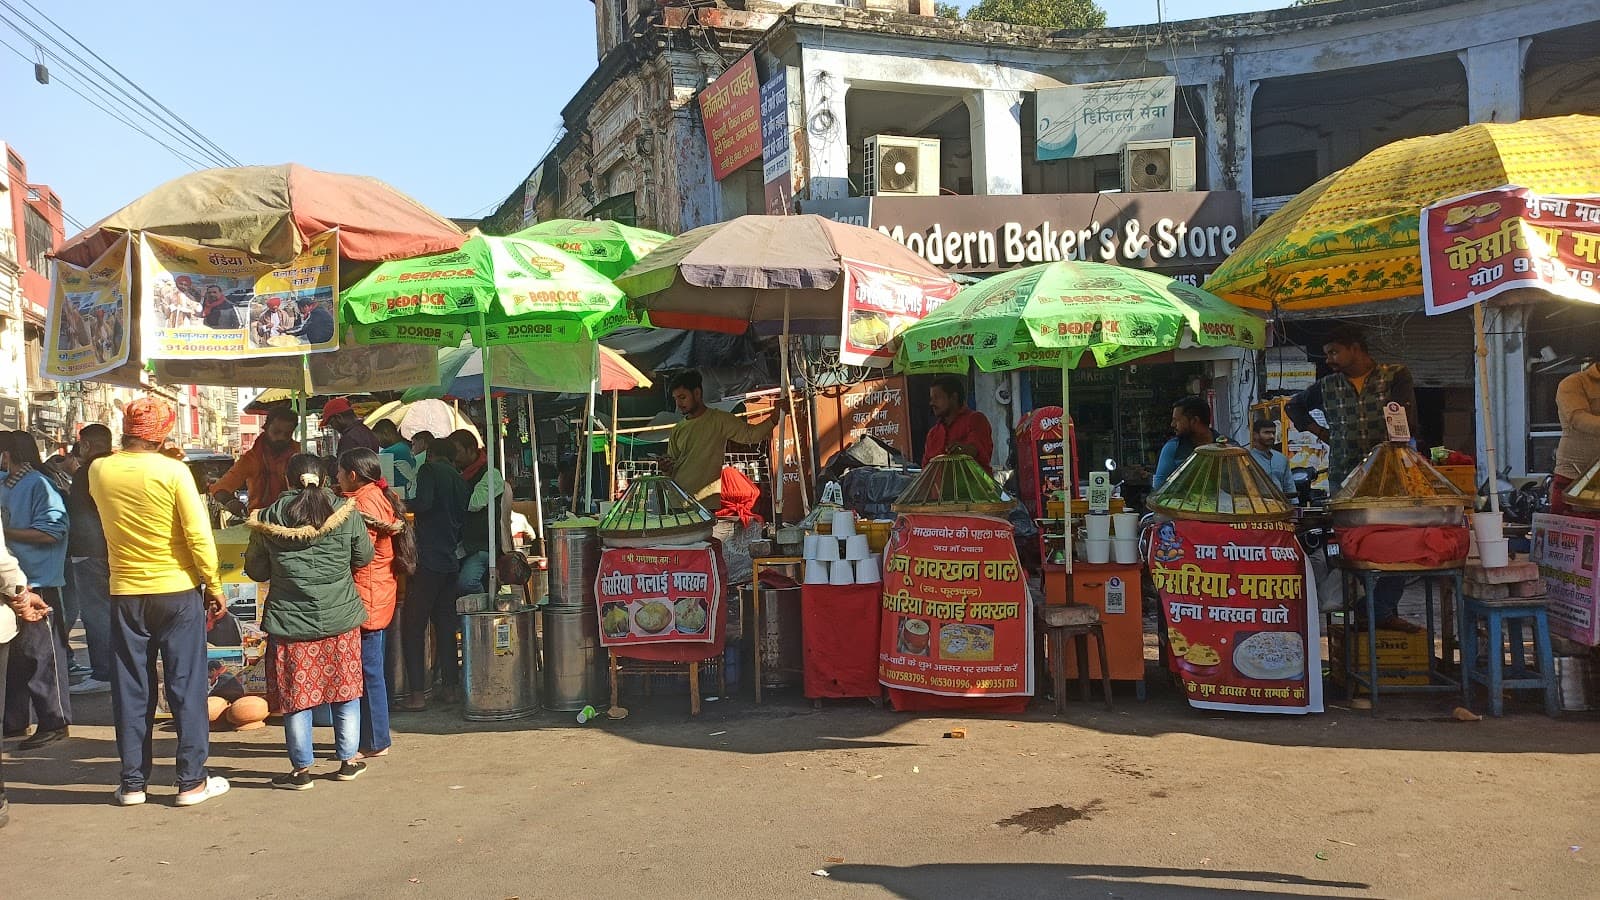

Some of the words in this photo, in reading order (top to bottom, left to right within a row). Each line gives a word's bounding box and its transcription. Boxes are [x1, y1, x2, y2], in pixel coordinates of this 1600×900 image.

[1082, 106, 1135, 125] डिजिटल
[1140, 102, 1168, 119] सेवा
[876, 223, 996, 265] Modern
[1004, 220, 1116, 264] Baker's
[1124, 218, 1150, 260] &
[1156, 217, 1237, 260] Store
[386, 292, 447, 311] BEDROCK
[528, 290, 580, 304] BEDROCK
[1058, 320, 1120, 336] BEDROCK
[844, 391, 865, 410] वाहन
[853, 411, 871, 424] वाहन
[956, 526, 968, 539] की
[1194, 545, 1218, 560] राम
[1222, 542, 1267, 561] गोपाल
[914, 557, 980, 581] मक्खन
[983, 553, 1019, 582] वाले
[600, 570, 633, 596] केसरिया
[635, 570, 669, 595] मलाई
[672, 572, 708, 593] मक्खन
[1151, 561, 1231, 598] केसरिया
[1238, 574, 1302, 600] मक्खन
[925, 596, 966, 622] मलाई
[969, 601, 1020, 621] मक्खन
[1169, 602, 1204, 623] मुन्ना
[1207, 605, 1257, 624] मक्खन
[1260, 604, 1289, 625] वाले
[934, 664, 961, 673] अवसर
[962, 666, 974, 674] पर
[975, 663, 1001, 673] सम्पर्क
[1200, 683, 1217, 697] शुभ
[1219, 685, 1248, 697] अवसर
[1250, 687, 1261, 698] पर
[1264, 687, 1290, 699] सम्पर्क
